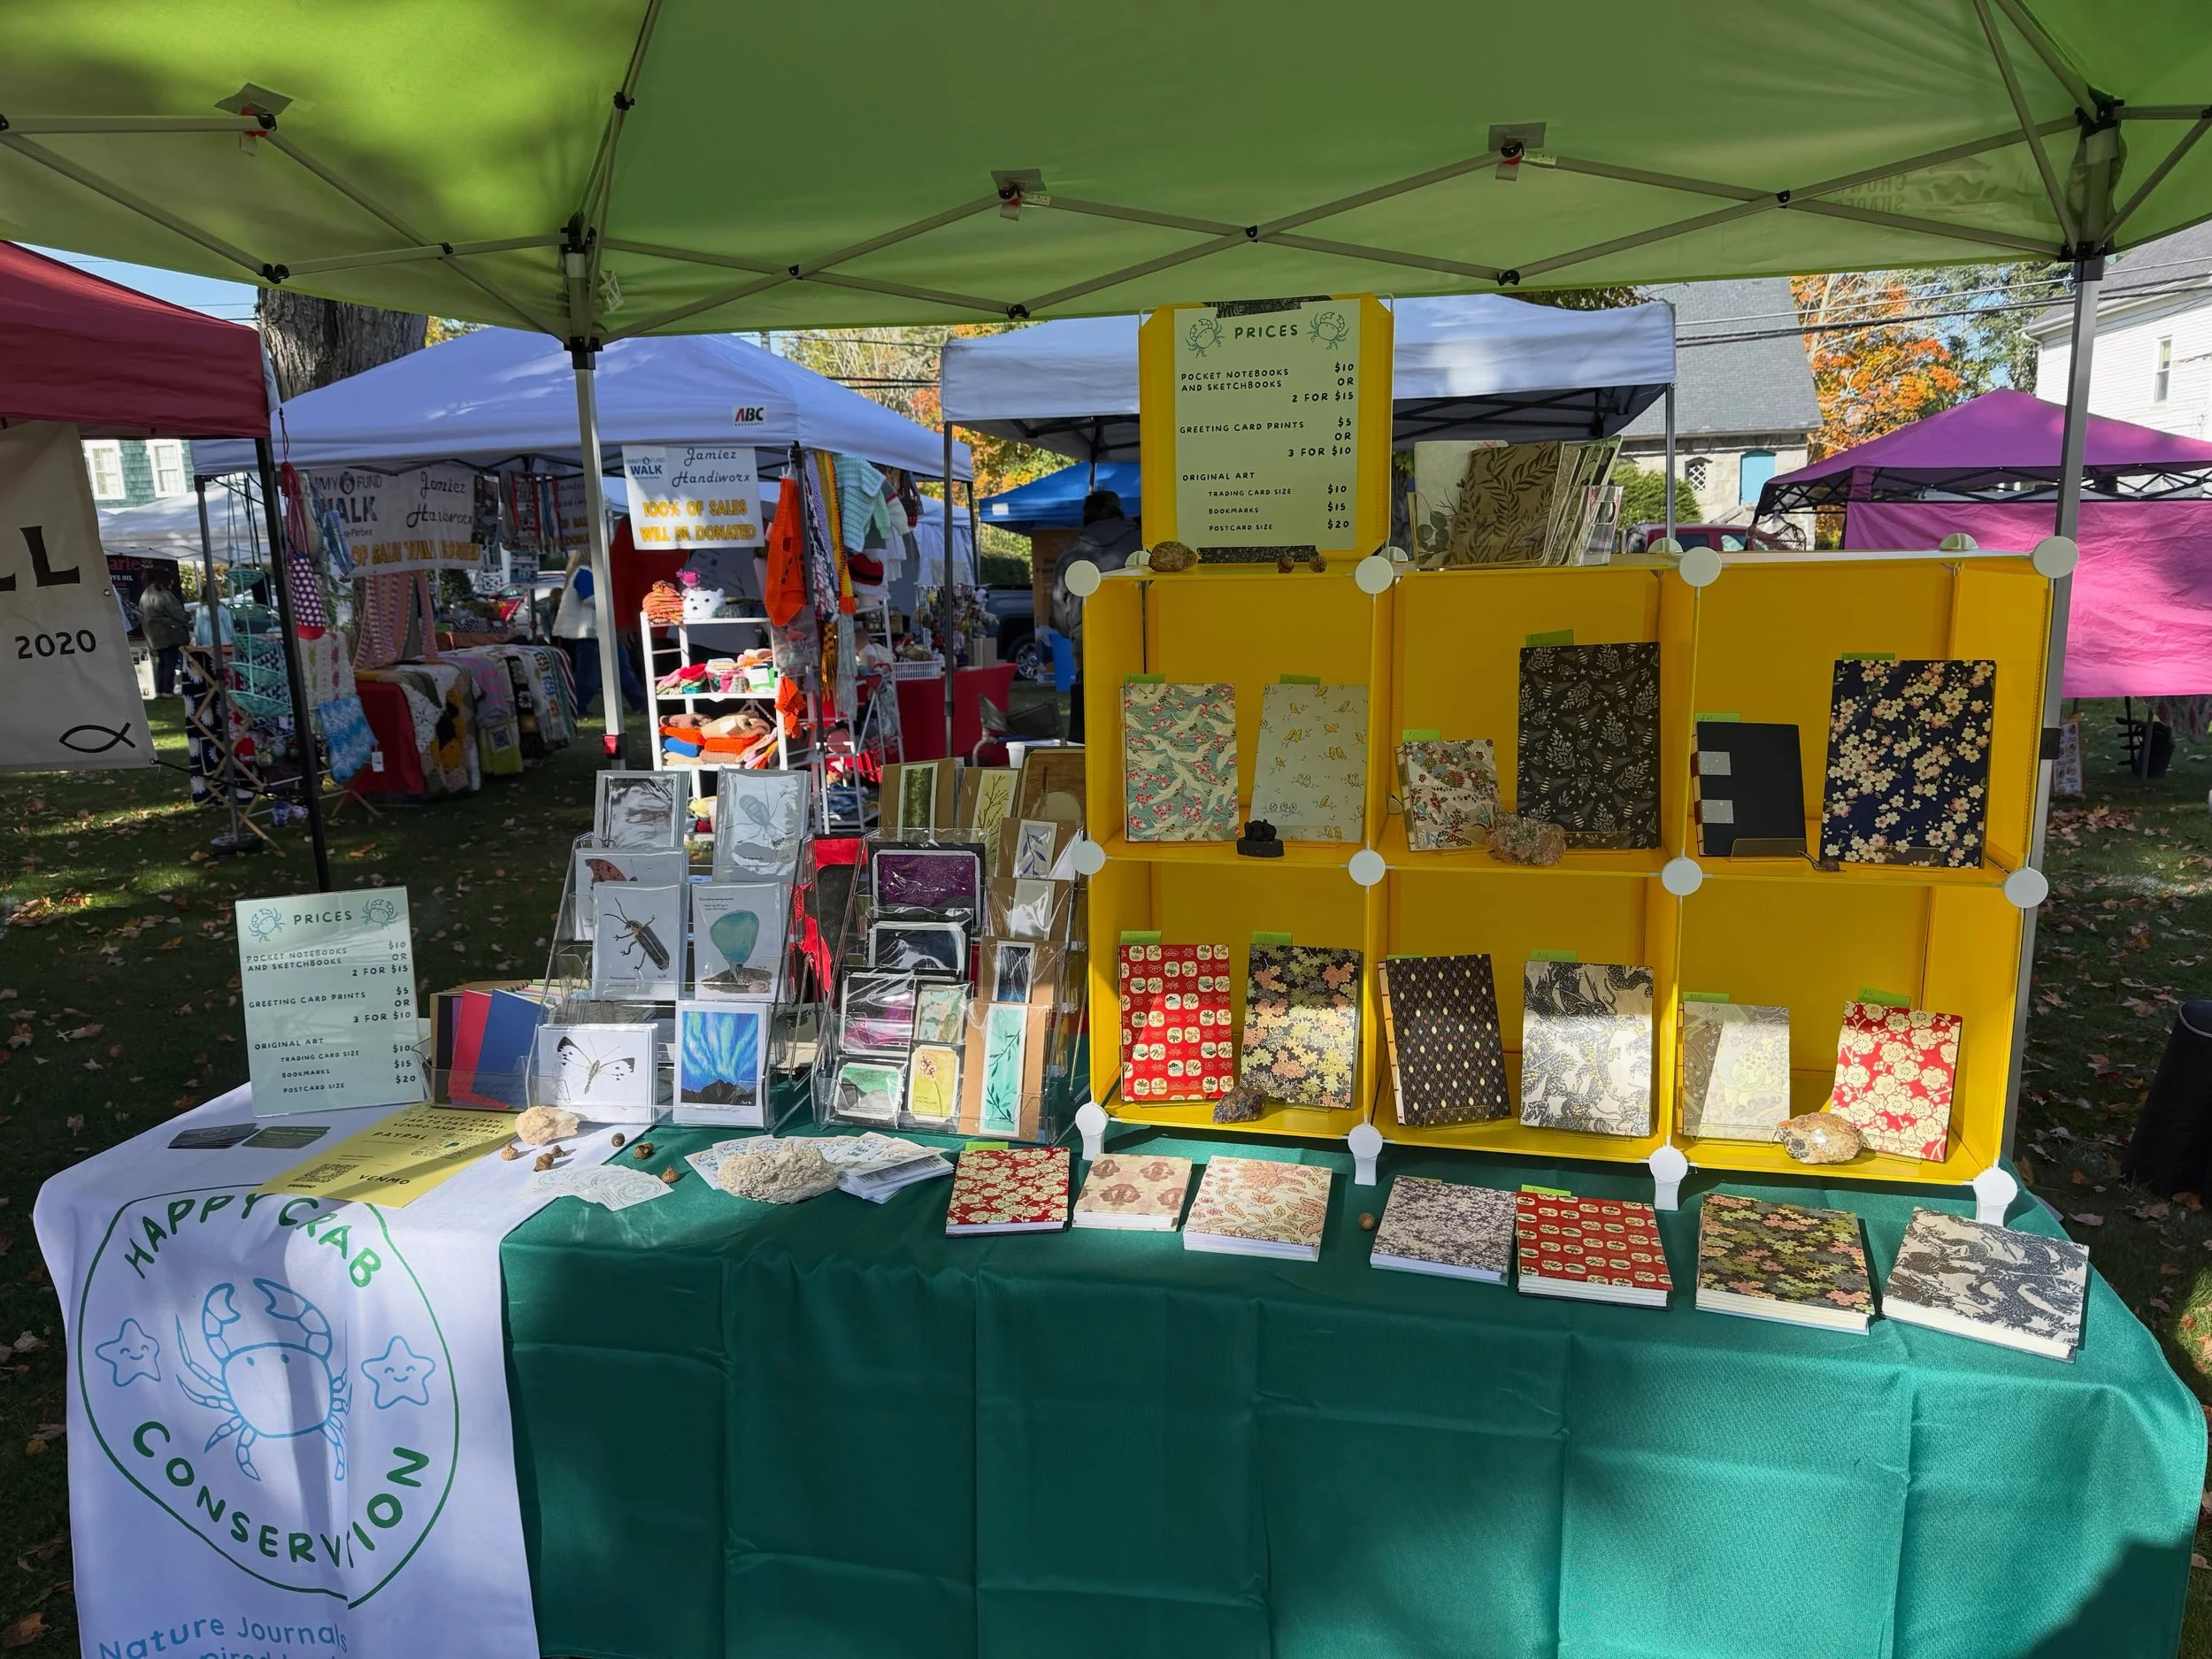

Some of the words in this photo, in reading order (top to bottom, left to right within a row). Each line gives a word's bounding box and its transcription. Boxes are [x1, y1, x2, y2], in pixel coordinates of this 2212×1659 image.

[1233, 324, 1299, 340] PRICES
[1180, 372, 1222, 381] POCKET
[1225, 368, 1289, 379] NOTEBOOKS
[1333, 362, 1355, 373] $10
[1180, 383, 1202, 392] AND
[1207, 380, 1282, 391] SKETCHBOOKS
[1337, 377, 1354, 387] OR
[1291, 394, 1298, 403] 2
[1303, 392, 1328, 402] FOR
[1334, 390, 1354, 402] $15
[735, 407, 764, 421] ABC
[1179, 424, 1230, 434] GREETING
[1233, 422, 1263, 432] CARD
[1266, 420, 1304, 430] PRINTS
[1337, 416, 1352, 428] $5
[1334, 432, 1352, 442] OR
[684, 447, 736, 466] Jamiez
[1287, 449, 1294, 457] 3
[1301, 447, 1325, 457] FOR
[1331, 445, 1352, 457] $10
[630, 465, 663, 475] WALK
[1182, 472, 1231, 482] ORIGINAL
[1234, 472, 1255, 480] ART
[672, 471, 750, 487] Handiworx
[1327, 483, 1347, 495] $10
[642, 500, 680, 517] 100%
[687, 500, 703, 516] OF
[710, 499, 747, 516] SALES
[1208, 506, 1259, 515] BOOKMARKS
[1327, 501, 1346, 512] $15
[1327, 518, 1349, 531] $20
[639, 526, 671, 541] WILL
[675, 524, 690, 541] BE
[695, 524, 757, 541] DONATED
[0, 526, 81, 591] L
[15, 629, 96, 659] 2020
[293, 910, 353, 926] PRICES
[388, 940, 406, 950] $10
[245, 953, 285, 963] POCKET
[288, 947, 348, 959] NOTEBOOKS
[248, 964, 268, 972] AND
[272, 958, 342, 970] SKETCHBOOKS
[363, 966, 386, 977] FOR
[391, 964, 409, 975] $15
[249, 997, 296, 1009] GREETING
[300, 995, 327, 1004] CARD
[331, 991, 366, 1001] PRINTS
[396, 986, 410, 996] $5
[394, 999, 411, 1008] OR
[353, 1015, 359, 1024] 3
[365, 1013, 388, 1023] FOR
[393, 1010, 411, 1021] $10
[254, 1040, 301, 1050] ORIGINAL
[304, 1037, 325, 1046] ART
[280, 1054, 316, 1063] TRADING
[392, 1043, 411, 1054] $10
[281, 1069, 331, 1079] BOOKMARKS
[394, 1060, 411, 1070] $15
[282, 1084, 325, 1094] POSTCARD
[396, 1074, 416, 1084] $20
[372, 1131, 428, 1141] PAYPAL
[359, 1174, 411, 1185] VENMO
[133, 1421, 430, 1569] CONSERVION
[99, 1617, 225, 1659] Nature
[237, 1617, 349, 1654] Journals
